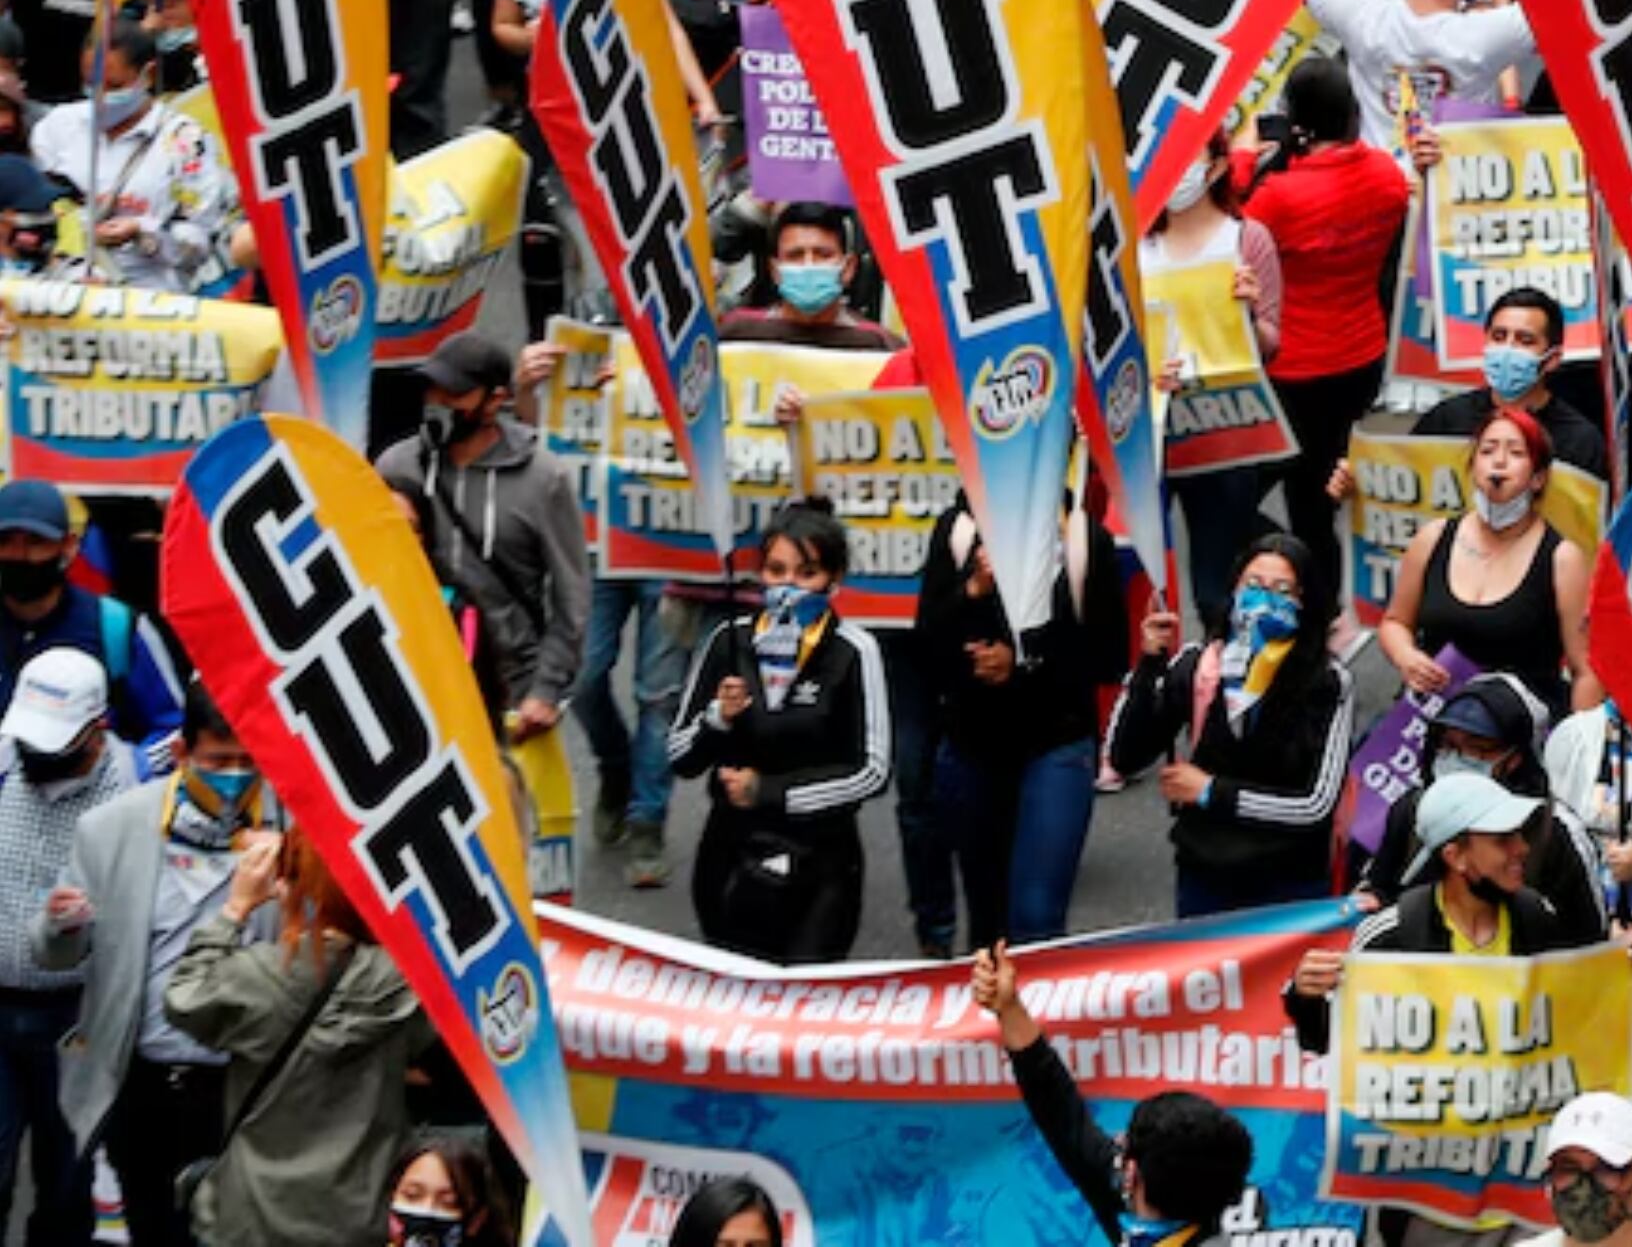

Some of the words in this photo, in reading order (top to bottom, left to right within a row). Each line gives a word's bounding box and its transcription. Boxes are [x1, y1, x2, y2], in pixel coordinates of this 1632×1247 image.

[770, 109, 807, 130] DE
[760, 136, 837, 161] GENT
[1451, 158, 1508, 202] NO
[1521, 158, 1554, 200] A
[1454, 212, 1589, 256] REFOR
[21, 332, 226, 384] REFORMA
[812, 421, 877, 463] NO
[891, 420, 922, 464] A
[817, 473, 958, 518] REFOR
[1361, 464, 1420, 503] NO
[1433, 465, 1462, 503] A
[217, 455, 504, 970] CUT
[578, 952, 932, 1025] democracia
[940, 985, 971, 1028] y
[998, 972, 1171, 1025] ontra
[1185, 962, 1241, 1015] el
[1361, 996, 1435, 1051] NO
[1448, 995, 1483, 1048] A
[1501, 993, 1550, 1048] LA
[683, 1030, 706, 1074] y
[726, 1032, 779, 1077] la
[1358, 1058, 1576, 1123] REFORMA
